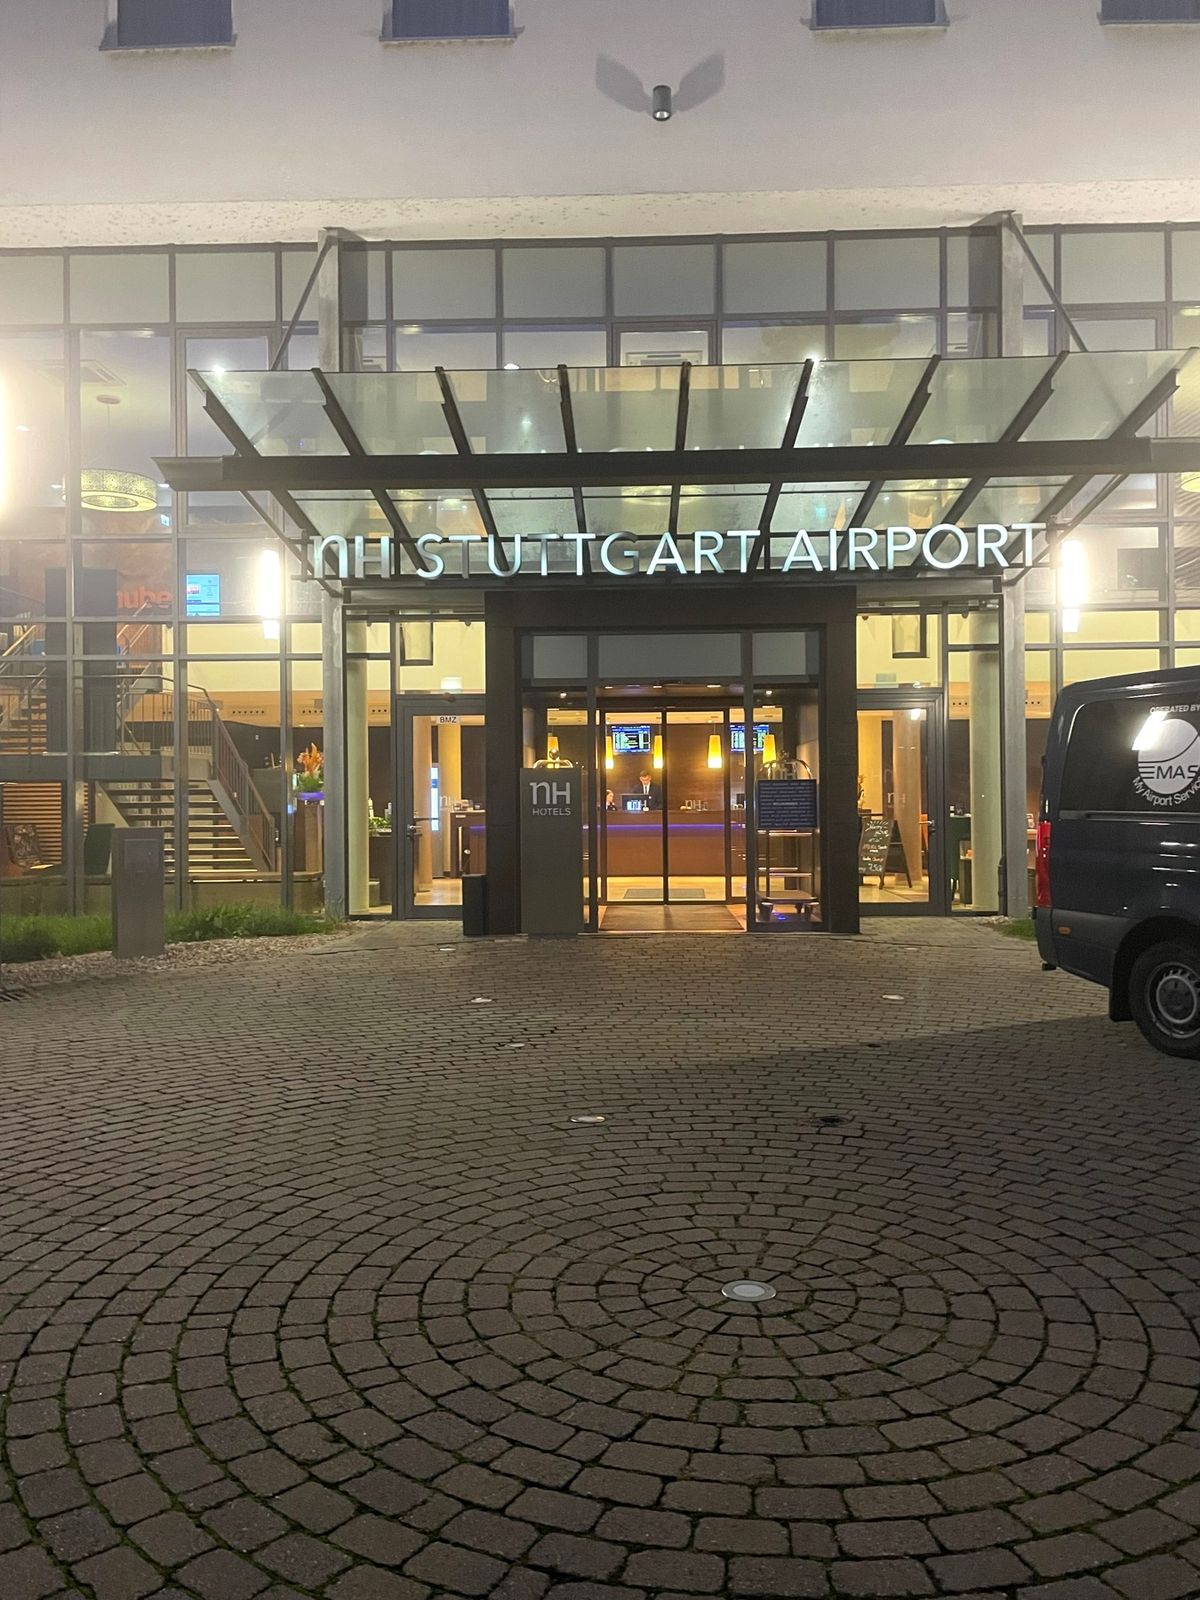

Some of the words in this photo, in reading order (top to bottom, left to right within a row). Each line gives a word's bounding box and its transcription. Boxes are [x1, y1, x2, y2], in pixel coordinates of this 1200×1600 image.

[416, 529, 761, 580] STUTTGART
[782, 523, 1047, 573] AIRPORT
[1150, 705, 1189, 714] OPERATED
[439, 716, 458, 724] BMZ
[529, 781, 571, 805] nH
[1132, 776, 1145, 794] My
[1142, 788, 1173, 806] Airport
[1173, 776, 1200, 805] Servic
[532, 807, 572, 816] HOTELS
